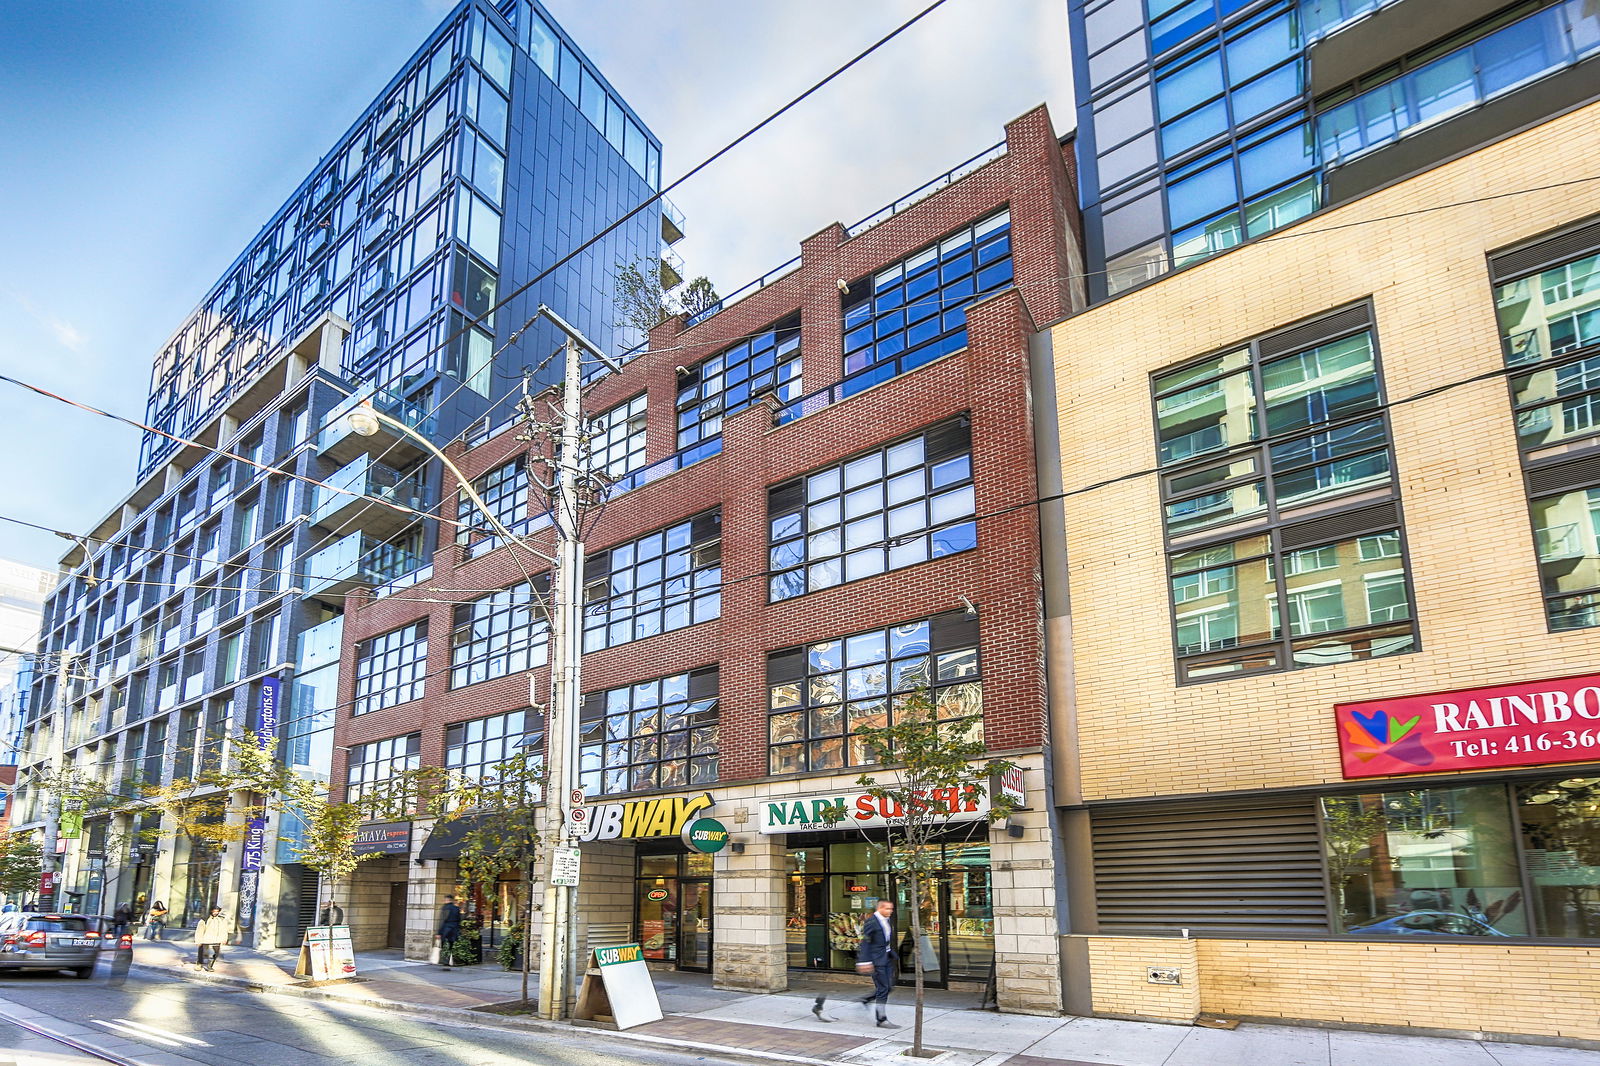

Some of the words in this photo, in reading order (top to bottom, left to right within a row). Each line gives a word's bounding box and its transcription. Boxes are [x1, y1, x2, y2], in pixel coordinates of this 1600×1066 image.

[1450, 738, 1498, 758] Tel:
[1504, 729, 1600, 753] 416-36
[579, 793, 714, 842] UBWAY
[799, 822, 838, 831] TAKE-OUT
[246, 828, 264, 850] King
[691, 830, 727, 841] SUBWAY
[246, 850, 261, 868] 275
[600, 945, 640, 965] SUBWAY
